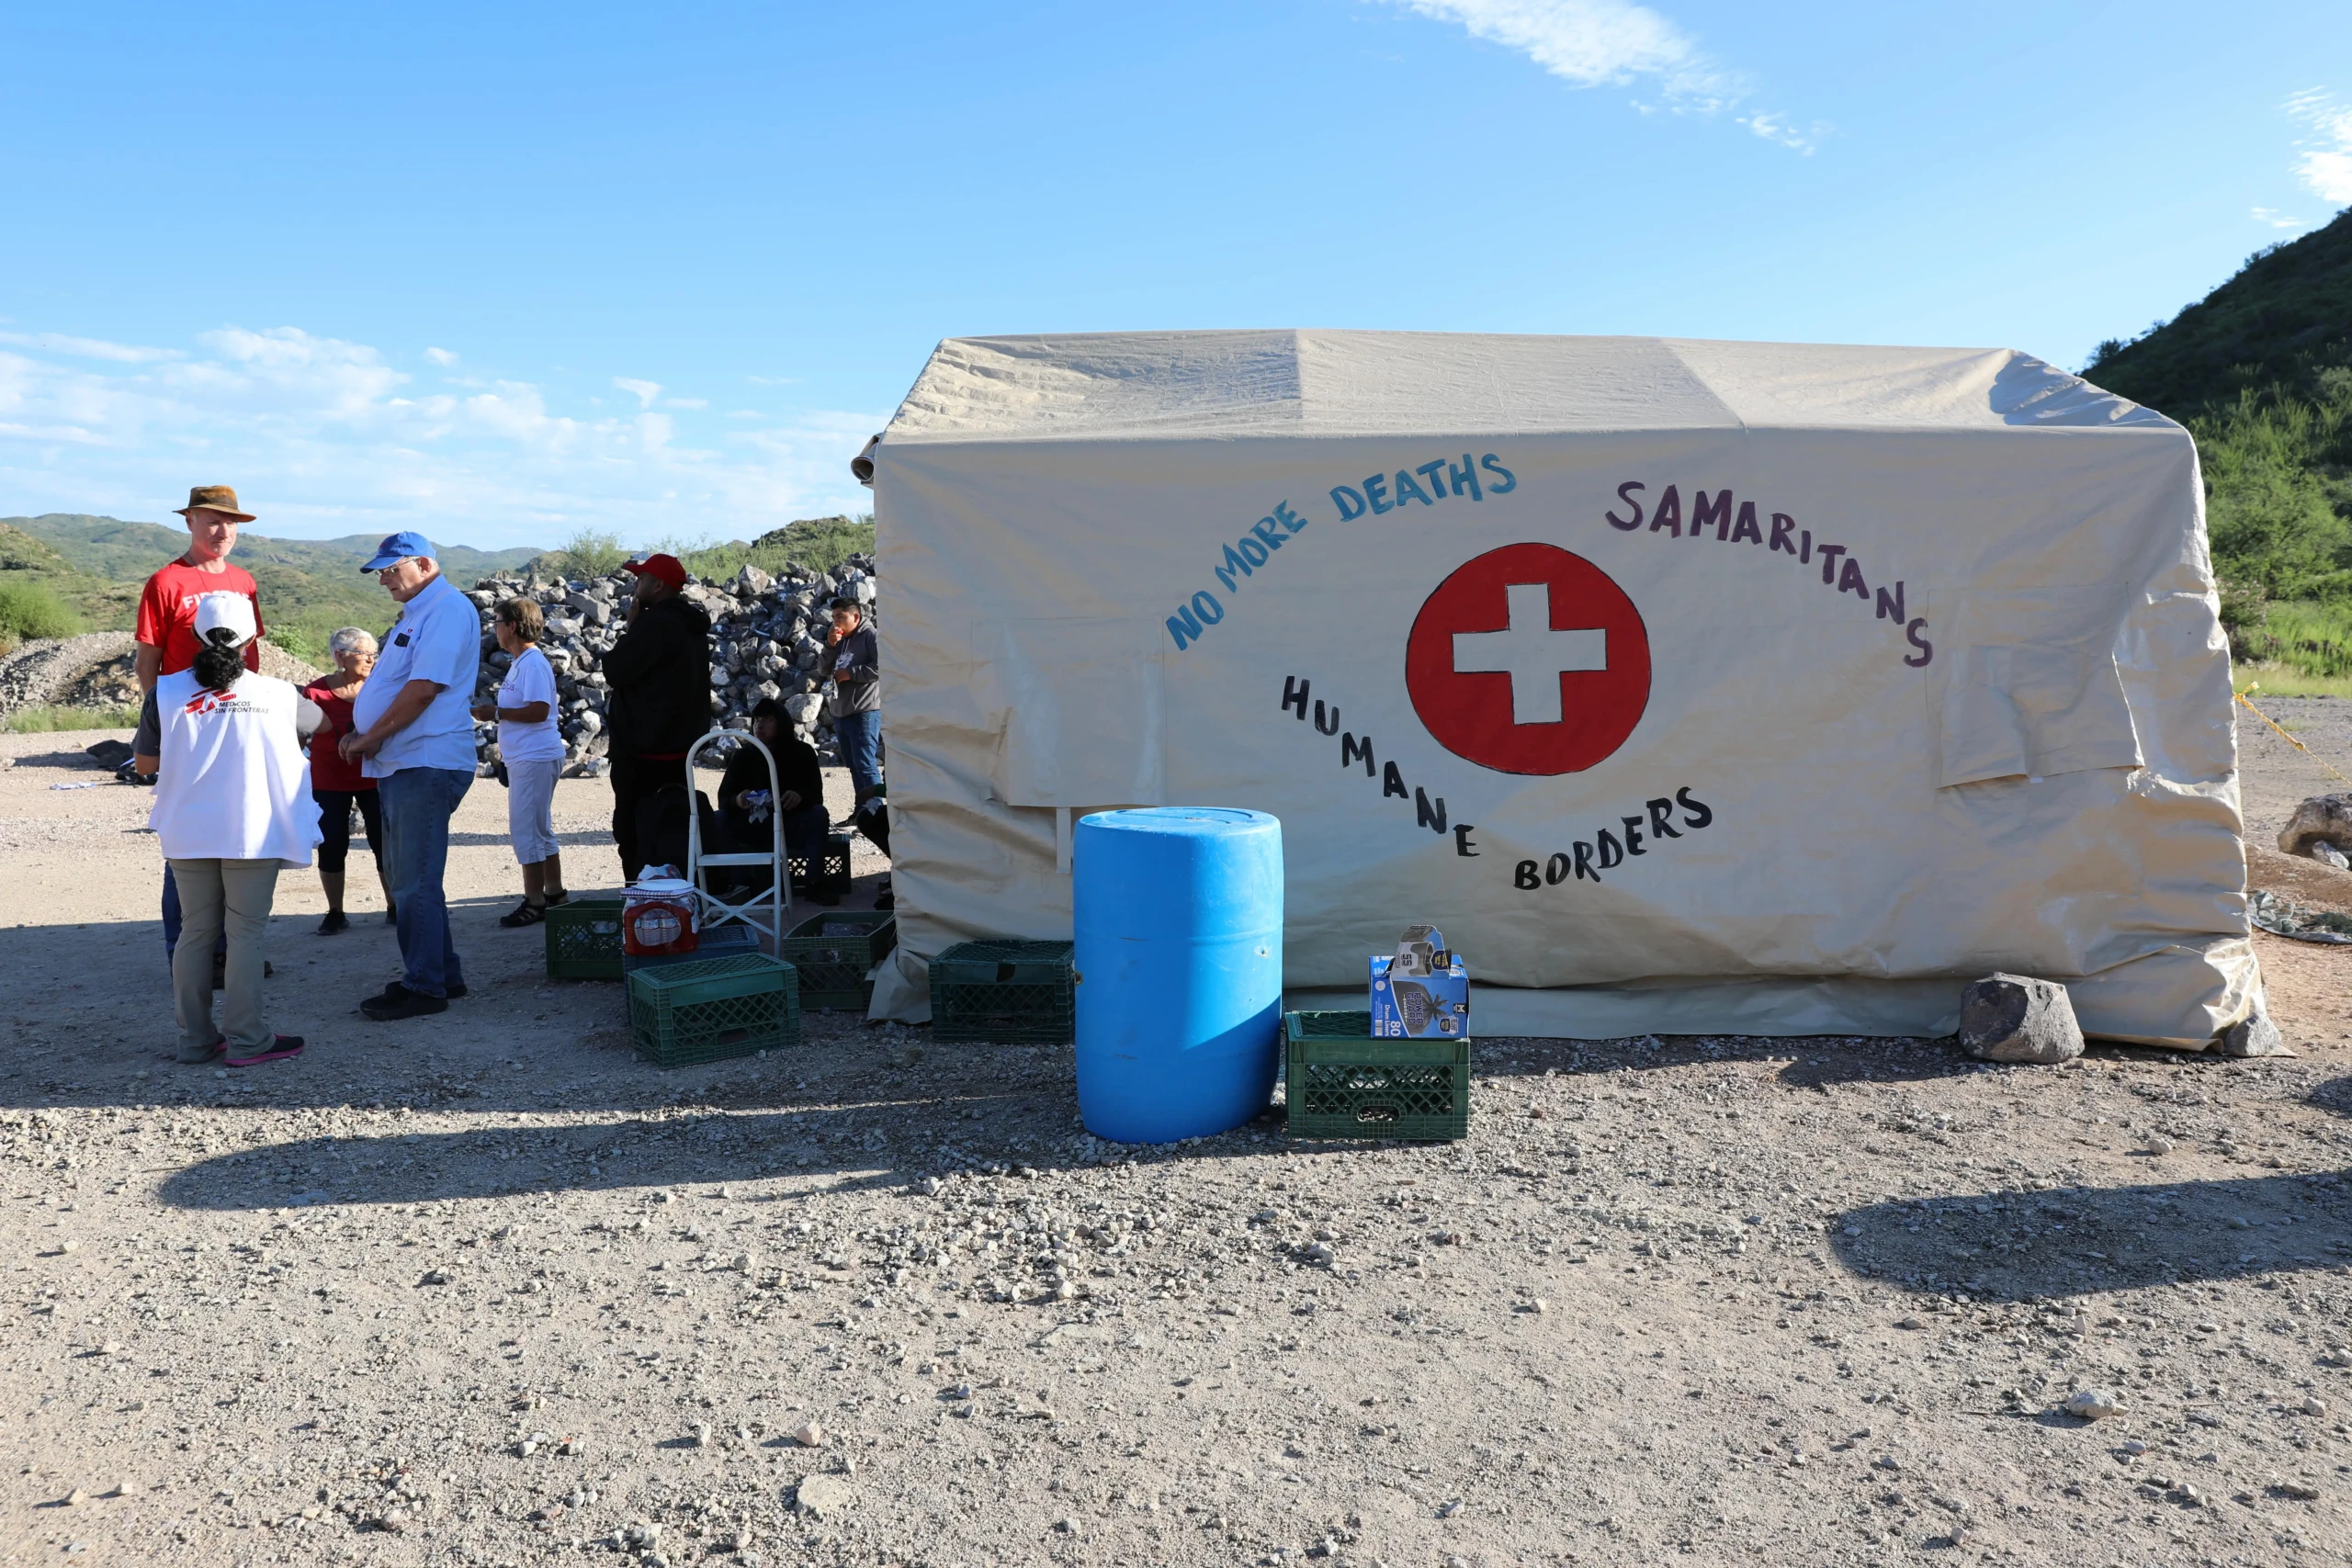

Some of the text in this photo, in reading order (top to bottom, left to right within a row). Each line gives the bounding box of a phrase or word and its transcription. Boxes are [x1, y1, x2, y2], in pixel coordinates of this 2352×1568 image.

[1165, 453, 1518, 651] NO MORE DEATHS
[1605, 480, 1933, 668] SAMARITANS
[1281, 675, 1713, 891] HUMANE BORDERS
[1401, 953, 1412, 966] 55
[1407, 992, 1416, 1025] GUARD
[1413, 992, 1424, 1025] POWER
[1390, 1021, 1401, 1037] 80
